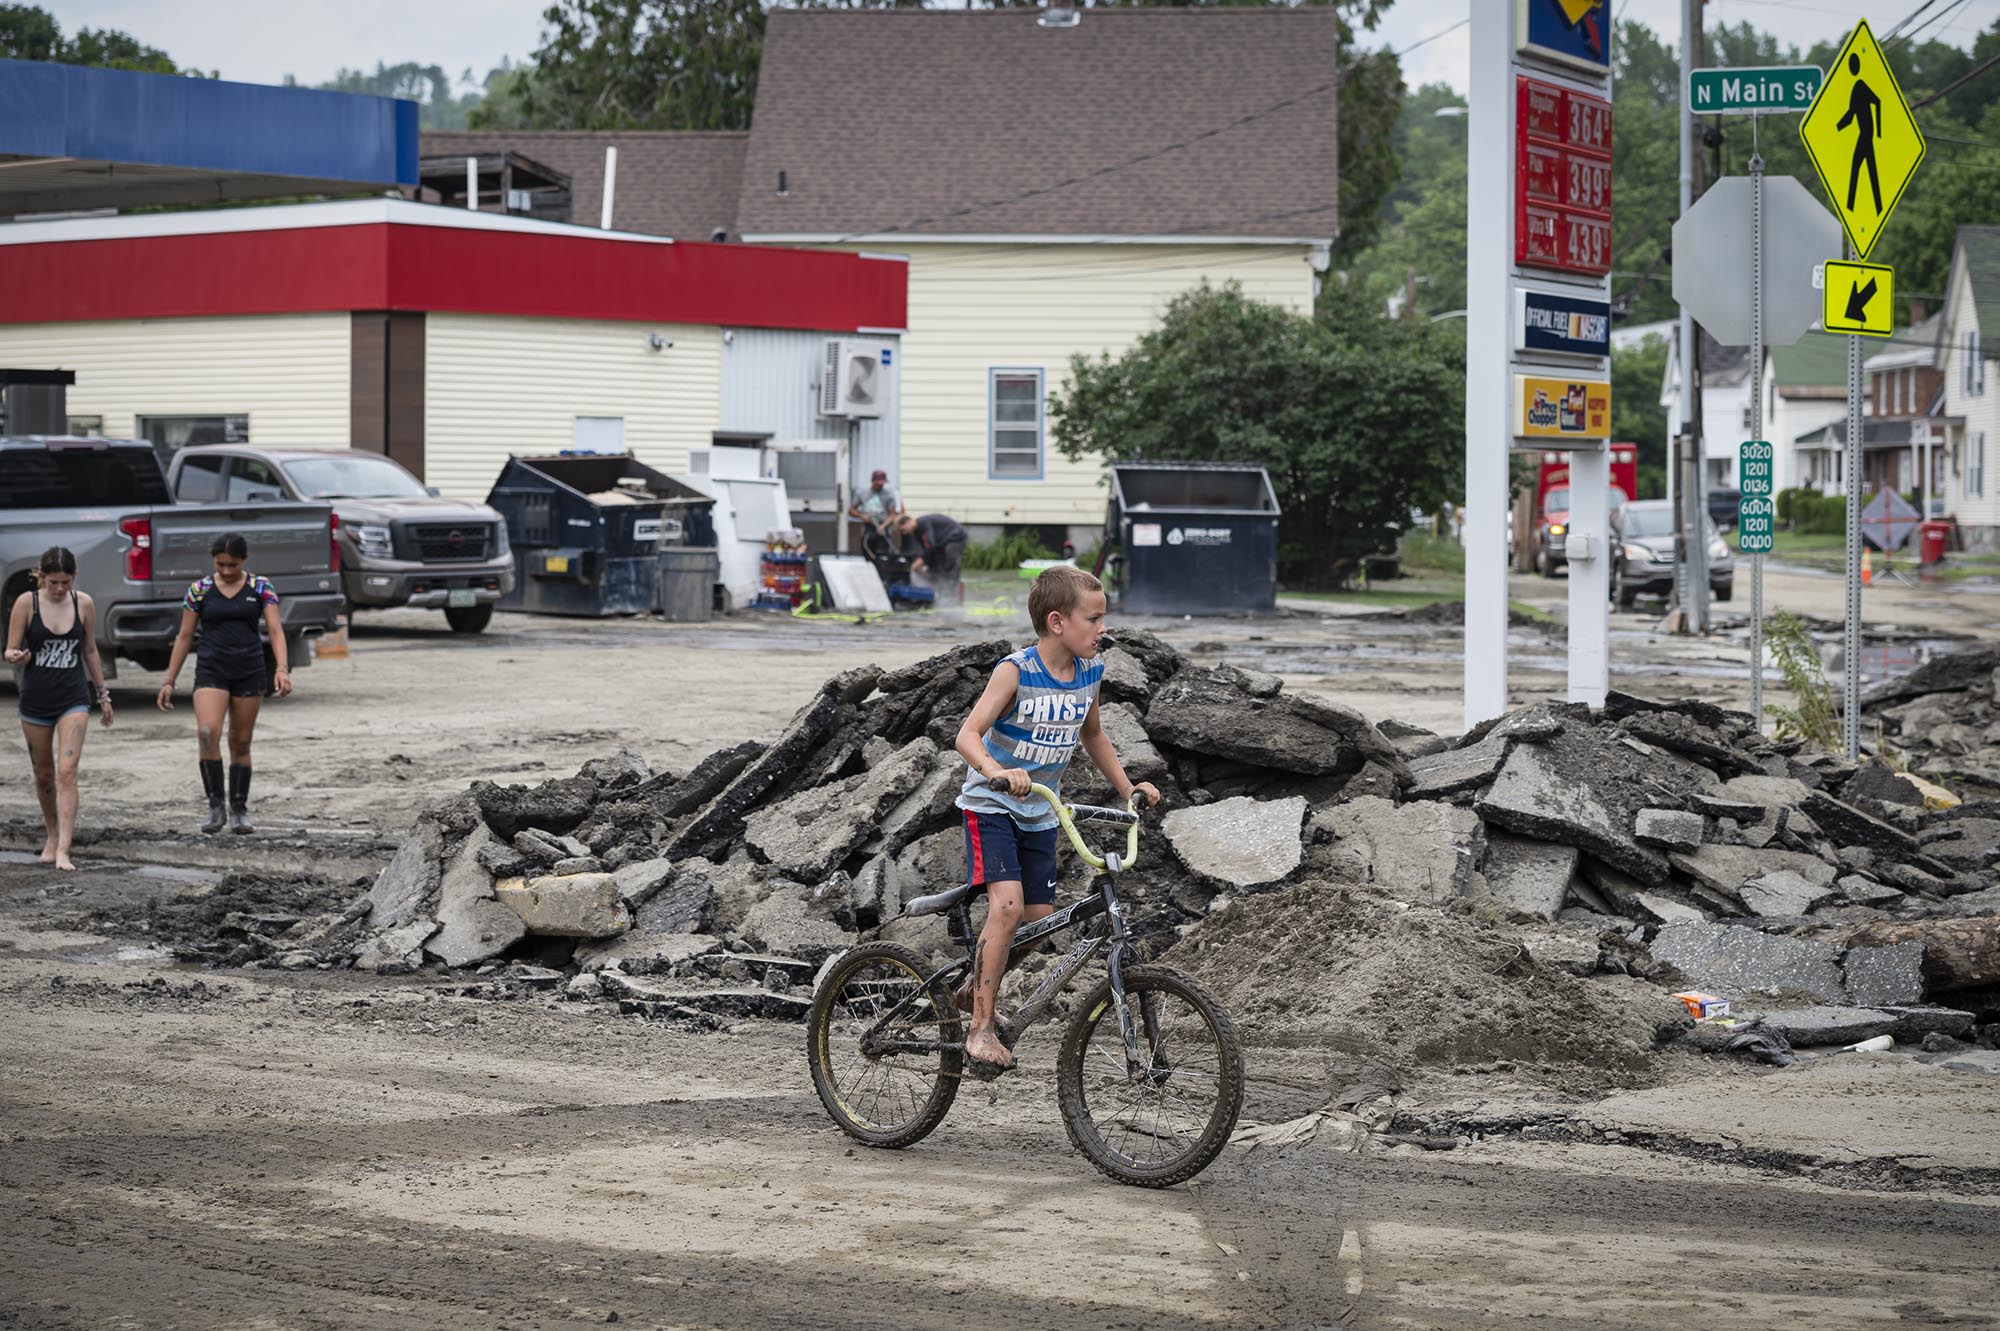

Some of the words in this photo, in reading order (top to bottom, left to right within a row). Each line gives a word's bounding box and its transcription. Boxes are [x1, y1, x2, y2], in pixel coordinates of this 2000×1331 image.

[1698, 84, 1711, 104] N
[1722, 77, 1784, 103] Main
[1794, 81, 1814, 101] St
[1570, 102, 1603, 147] 364
[1570, 162, 1602, 207] 399
[1568, 221, 1602, 267] 439
[1741, 445, 1771, 459] 3020
[1745, 462, 1768, 476] 1201
[1743, 479, 1769, 493] 0136
[1741, 501, 1771, 515] 6004
[1745, 518, 1768, 532] 1201
[1741, 535, 1772, 549] 0000
[41, 640, 79, 653] STAY
